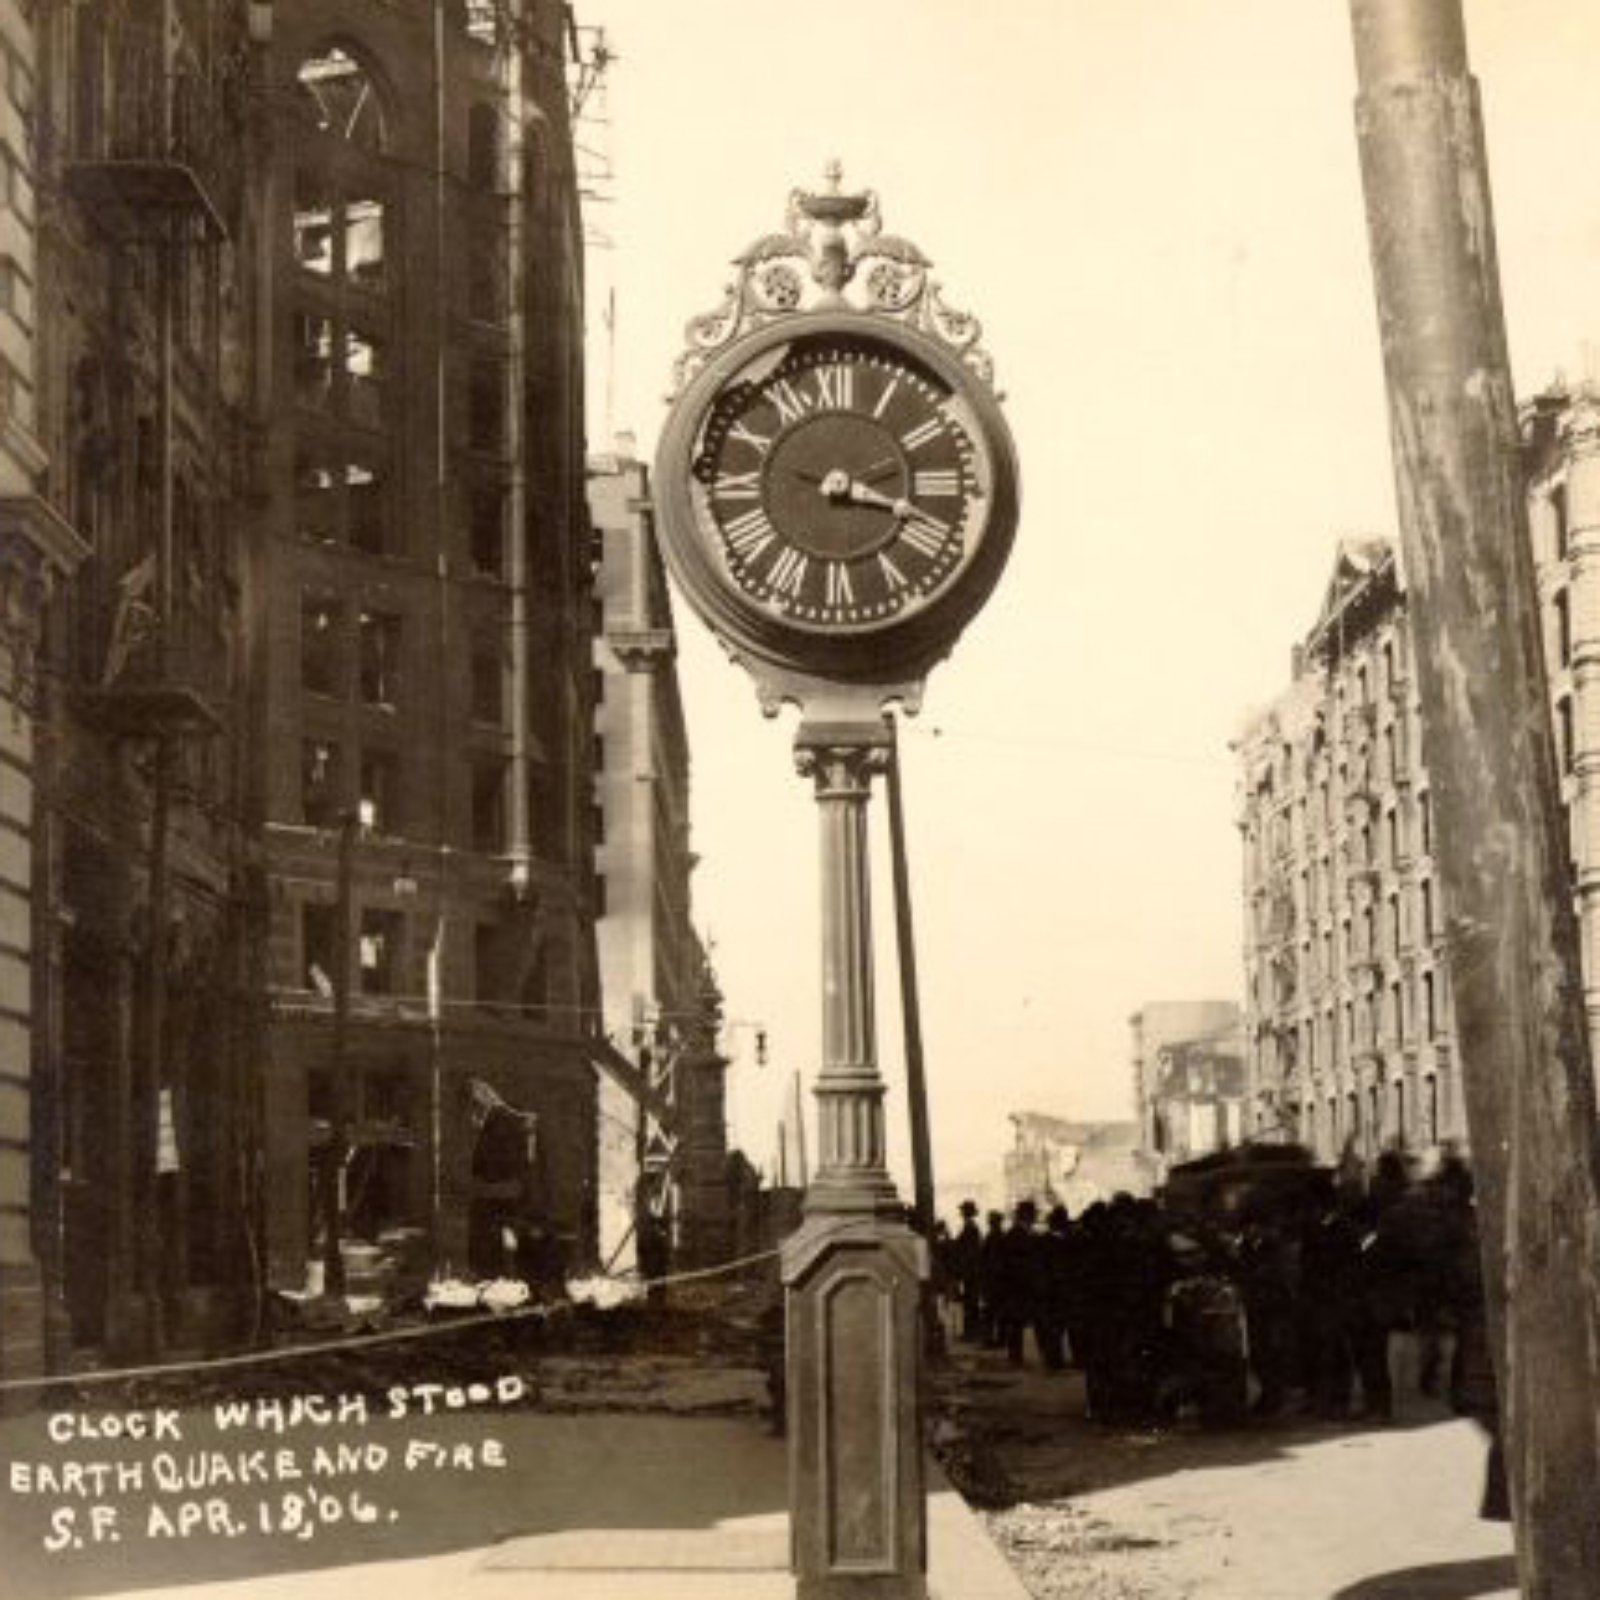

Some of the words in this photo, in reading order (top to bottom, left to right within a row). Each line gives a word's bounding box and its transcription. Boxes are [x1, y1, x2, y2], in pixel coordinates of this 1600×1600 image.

[814, 364, 853, 411] XII
[873, 378, 898, 418] I
[728, 420, 772, 454] X
[901, 416, 944, 451] II
[914, 470, 959, 496] III
[877, 551, 908, 591] V
